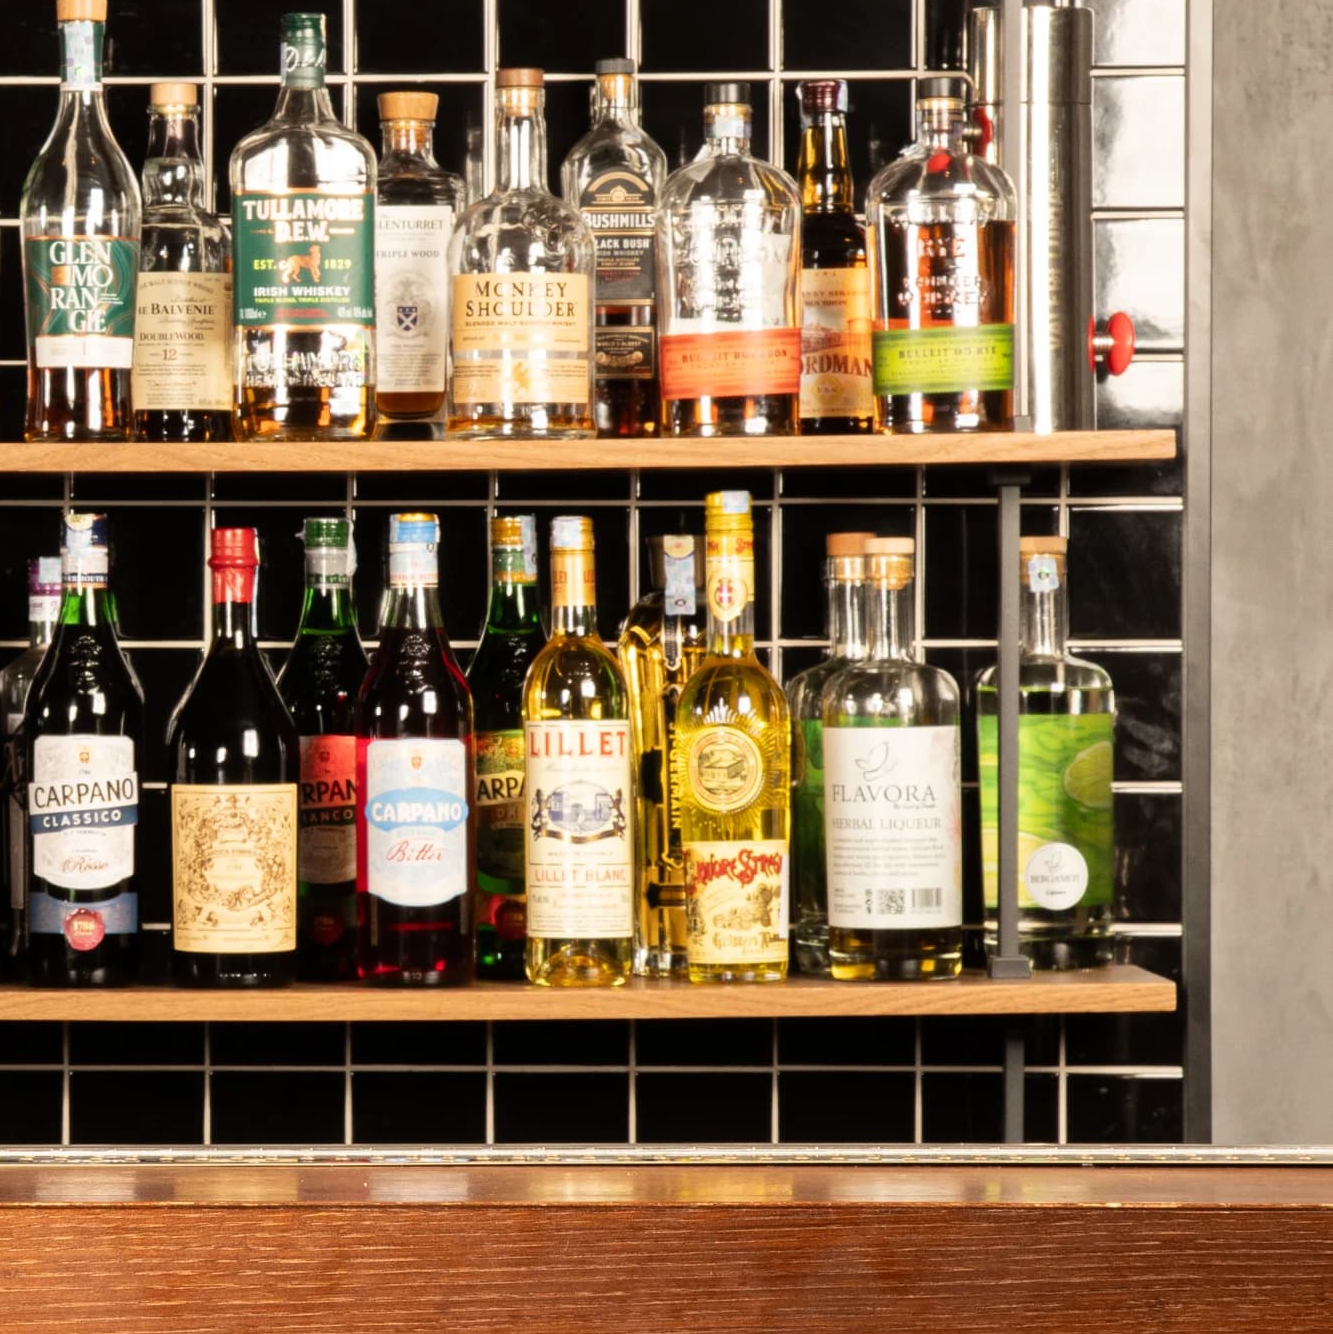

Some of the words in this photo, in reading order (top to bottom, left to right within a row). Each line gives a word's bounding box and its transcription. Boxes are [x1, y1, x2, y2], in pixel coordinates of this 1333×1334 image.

[242, 199, 364, 221] TULLAMORE
[582, 213, 655, 229] BUSHMILLS
[273, 220, 330, 244] D.E.W.
[596, 238, 620, 249] LACK
[622, 238, 650, 249] BUSH
[49, 240, 111, 265] GLEN
[376, 250, 409, 259] TRIPLE
[411, 250, 440, 258] WOOD
[253, 259, 277, 270] EST.
[324, 259, 353, 270] 1829
[72, 265, 114, 288] MO
[254, 286, 288, 297] IRISH
[291, 286, 351, 297] WHISKEY
[476, 281, 568, 298] MONKEY
[151, 302, 215, 316] BALVENIE
[465, 301, 577, 318] SHOULDER
[69, 310, 107, 333] GIE
[163, 349, 177, 361] 12
[899, 348, 949, 359] BULLEIT
[977, 345, 998, 355] RYE
[529, 731, 626, 757] LILLET
[34, 777, 134, 809] CARPANO
[302, 779, 356, 804] RPAN
[832, 784, 936, 803] FLAVORA
[42, 809, 123, 829] CLASSICO
[371, 801, 463, 824] CARPANO
[832, 818, 876, 831] HERBAL
[880, 818, 942, 832] LIQUEUR
[386, 839, 444, 863] Bitter
[585, 869, 626, 883] BLANC
[1030, 873, 1081, 885] BERGAMOT
